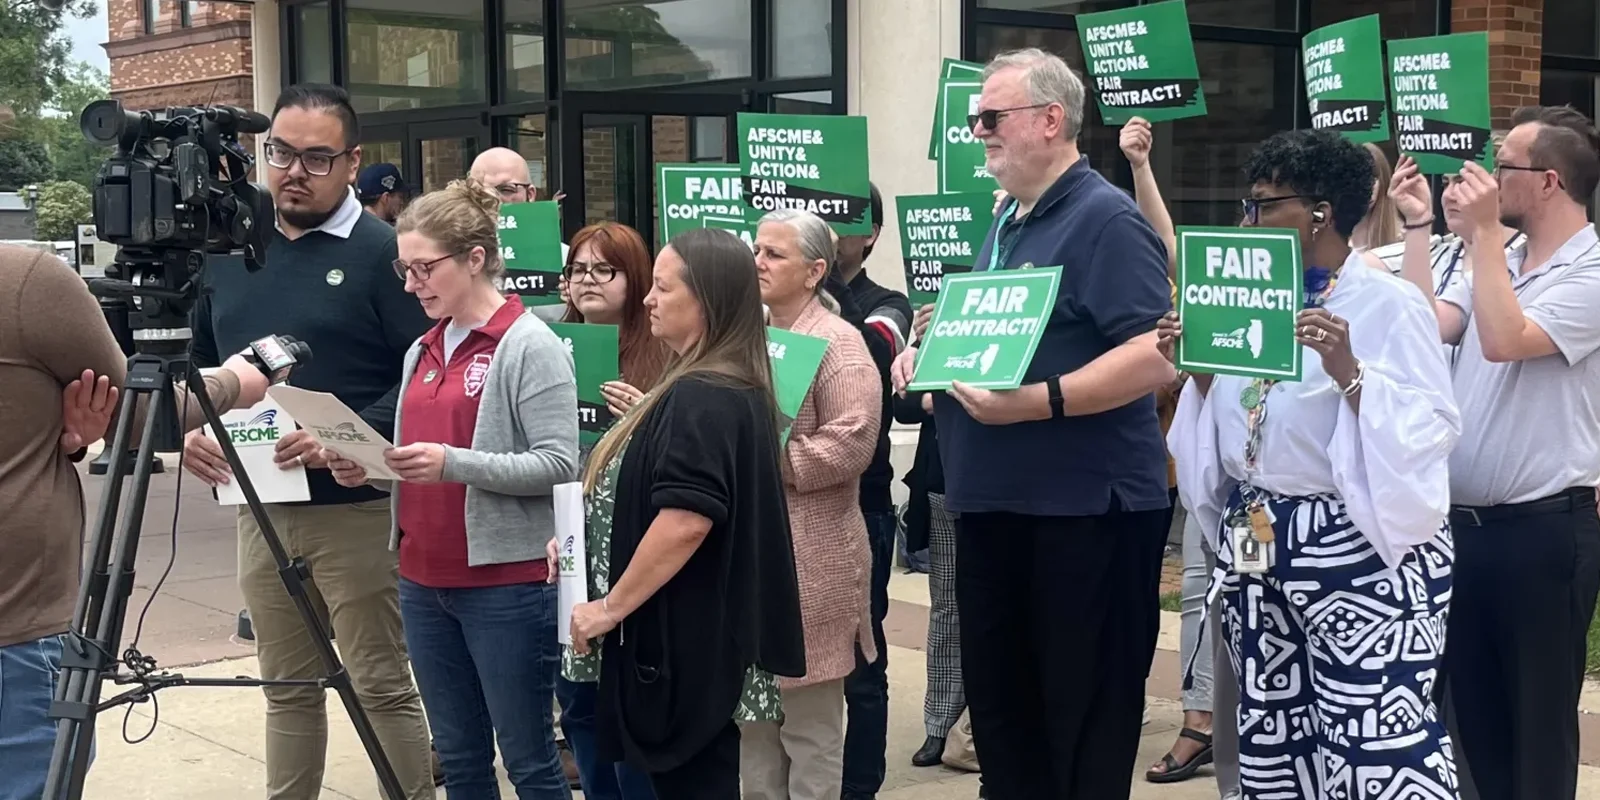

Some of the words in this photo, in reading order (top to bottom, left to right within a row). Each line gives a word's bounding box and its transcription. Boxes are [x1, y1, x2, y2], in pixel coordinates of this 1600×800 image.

[1086, 21, 1148, 41] AFSCME&
[1089, 40, 1135, 57] UNITY&
[1094, 55, 1149, 74] ACTION&
[1393, 52, 1451, 72] AFSCME&
[1096, 76, 1122, 90] FAIR
[1394, 74, 1437, 92] UNITY&
[1101, 84, 1182, 106] CONTRACT!
[1396, 93, 1449, 111] ACTION&
[1397, 115, 1424, 131] FAIR
[748, 128, 823, 145] AFSCME&
[1400, 133, 1472, 150] CONTRACT!
[749, 145, 807, 162] UNITY&
[750, 162, 820, 179] ACTION&
[197, 176, 203, 188] 5
[751, 179, 786, 195] FAIR
[752, 197, 849, 214] CONTRACT!
[906, 207, 972, 224] AFSCME&
[907, 225, 958, 241] UNITY&
[910, 242, 972, 258] ACTION&
[911, 260, 943, 275] FAIR
[1206, 246, 1272, 281] FAIR
[961, 286, 1029, 315] FAIR
[1185, 284, 1292, 311] CONTRACT!
[934, 317, 1039, 337] CONTRACT!
[231, 427, 280, 442] FSCME
